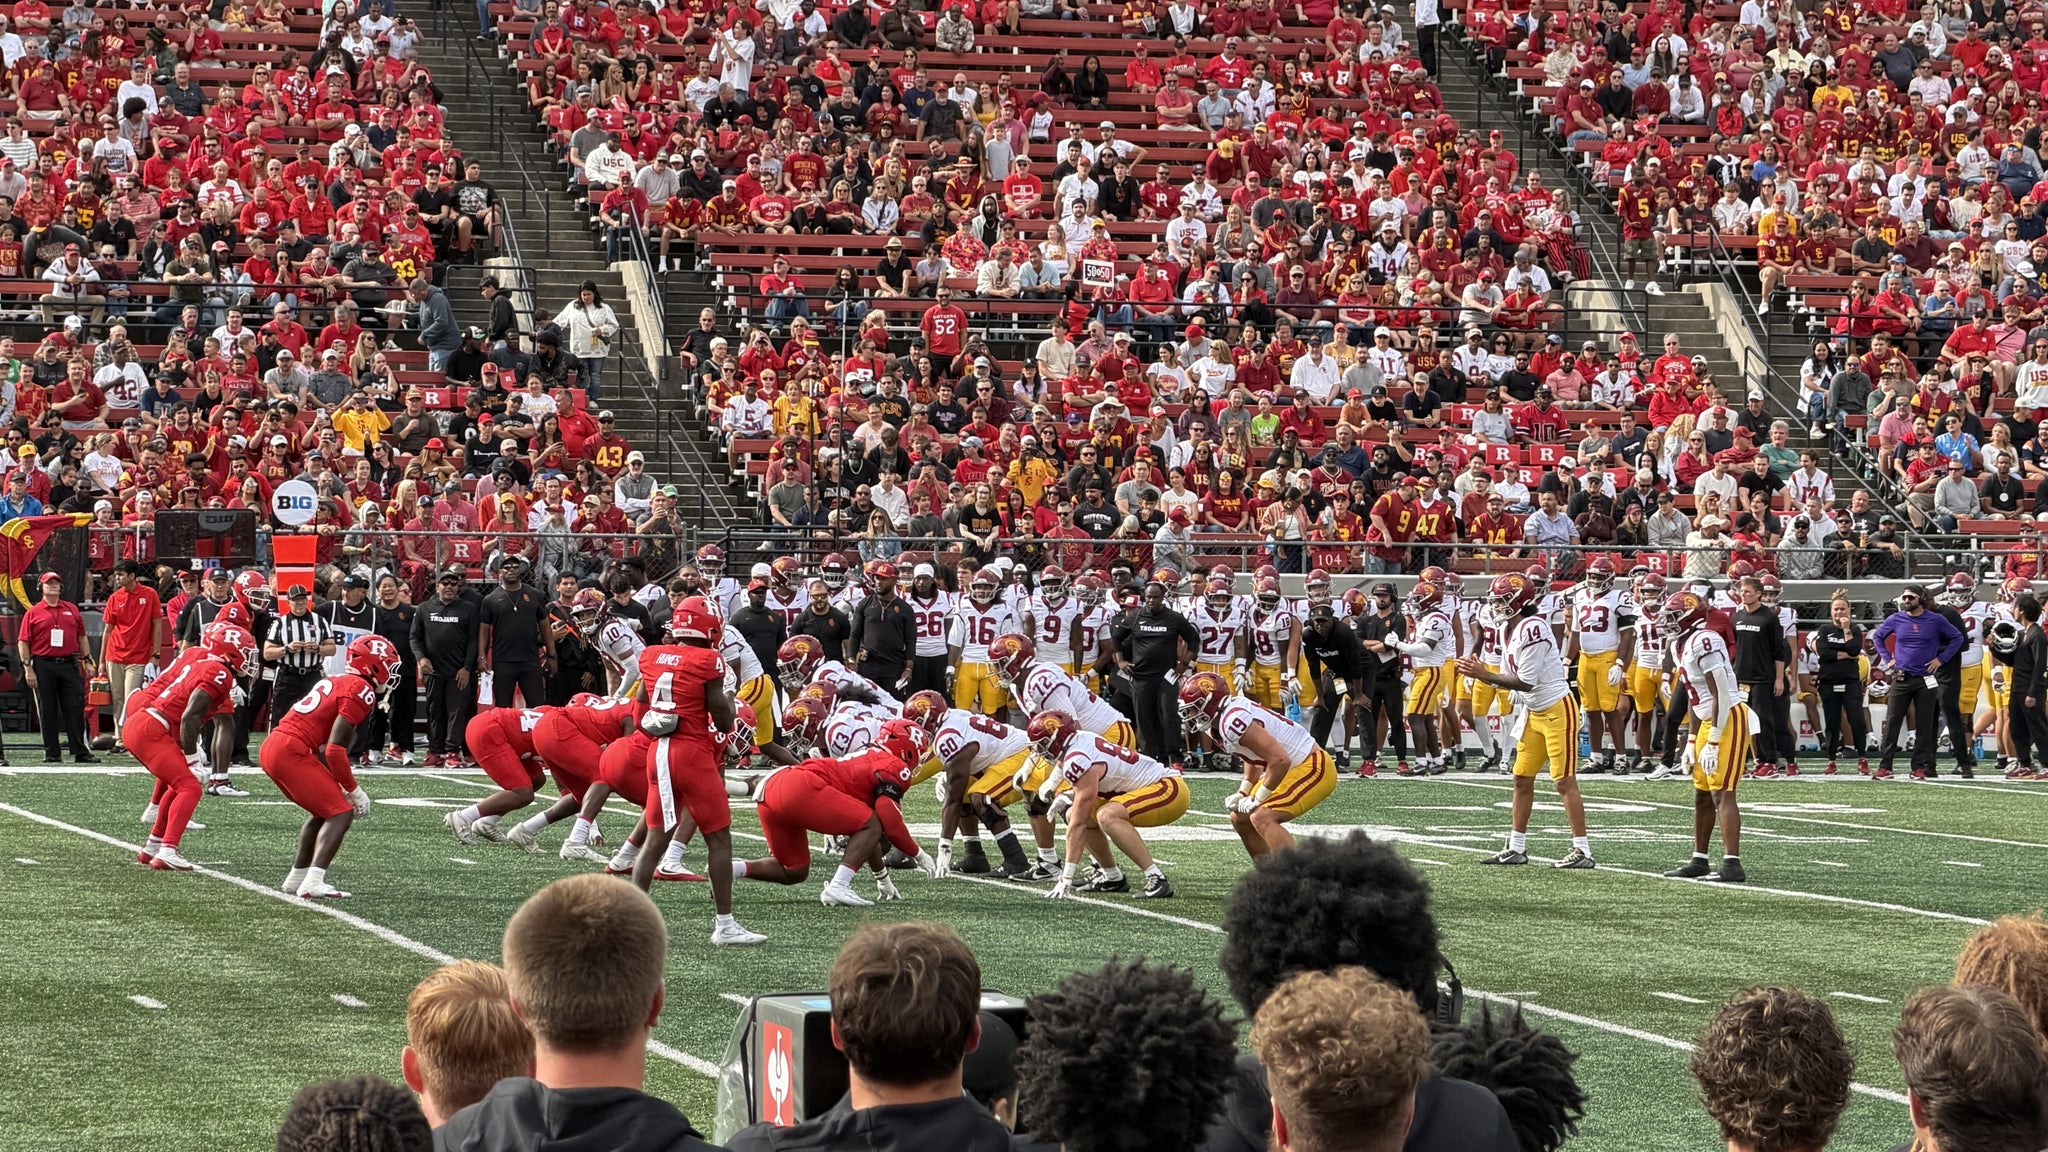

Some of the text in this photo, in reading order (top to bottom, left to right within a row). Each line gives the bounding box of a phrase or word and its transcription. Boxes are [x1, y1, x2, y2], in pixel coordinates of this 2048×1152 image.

[573, 16, 585, 28] R
[1474, 12, 1487, 23] R
[67, 71, 79, 89] 6
[1224, 72, 1235, 83] 7
[1300, 71, 1314, 83] R
[1336, 70, 1350, 86] R
[1842, 139, 1859, 157] 13
[602, 157, 625, 168] USC
[961, 193, 972, 209] 7
[1637, 197, 1650, 218] 5
[1339, 203, 1358, 220] R
[1179, 228, 1198, 238] USC
[1774, 245, 1791, 261] 11
[2005, 246, 2024, 255] USC
[392, 258, 417, 278] 33
[1156, 269, 1169, 281] R
[1382, 258, 1397, 277] 14
[934, 319, 955, 334] 52
[1417, 356, 1435, 367] USC
[2029, 369, 2048, 381] US
[113, 378, 138, 401] 42
[425, 391, 440, 404] R
[1610, 389, 1621, 406] 7
[744, 409, 756, 430] 5
[1461, 407, 1475, 420] R
[1928, 407, 1941, 428] 5
[1532, 421, 1557, 440] 10
[596, 445, 623, 467] 43
[1229, 453, 1246, 468] SC
[1496, 447, 1511, 460] R
[1539, 447, 1554, 461] R
[1194, 473, 1209, 485] US
[1518, 468, 1533, 483] R
[440, 514, 467, 524] RUTGERS
[449, 521, 459, 530] R
[1093, 522, 1102, 530] R
[1396, 510, 1411, 533] 9
[1415, 513, 1440, 536] 47
[1487, 527, 1506, 544] 14
[454, 543, 470, 558] R
[1317, 554, 1342, 566] 104
[1647, 556, 1663, 570] R
[237, 573, 251, 587] R
[228, 607, 238, 619] 5
[430, 614, 459, 623] TROJANS
[1578, 605, 1610, 633] 23
[914, 611, 944, 638] 26
[968, 615, 997, 645] 16
[1043, 615, 1062, 644] 9
[1431, 620, 1440, 630] 2
[1735, 624, 1760, 632] TROJANS
[223, 630, 242, 647] R
[606, 627, 620, 642] 10
[1201, 626, 1236, 656] 27
[1527, 625, 1541, 642] 14
[370, 640, 388, 658] R
[1255, 630, 1275, 656] 8
[1702, 637, 1712, 651] 8
[715, 657, 725, 673] 4
[213, 670, 227, 685] 2
[650, 671, 677, 711] 4
[1032, 675, 1052, 697] 72
[357, 685, 375, 706] 16
[584, 696, 602, 707] R
[1228, 717, 1248, 738] 19
[831, 731, 849, 753] 73
[909, 726, 924, 746] R
[939, 737, 959, 758] 60
[899, 767, 911, 781] 8
[1065, 761, 1085, 783] 84
